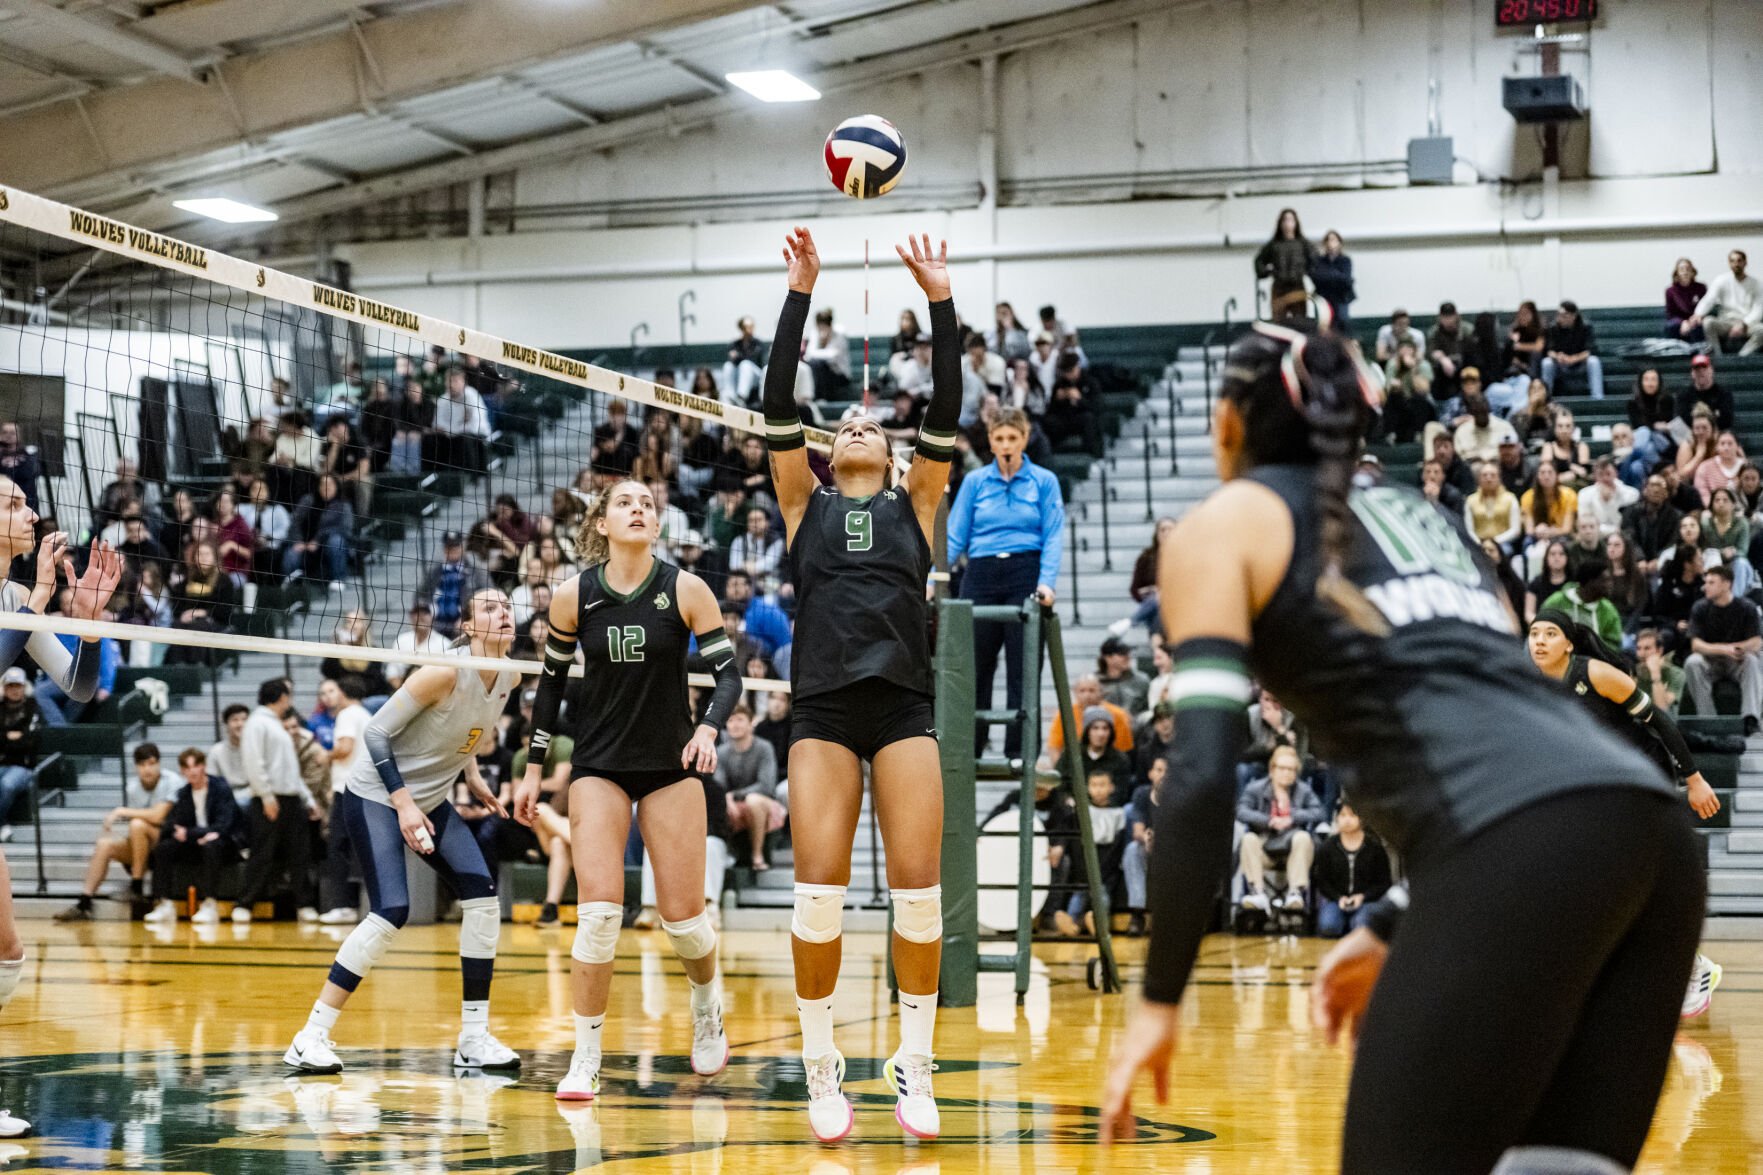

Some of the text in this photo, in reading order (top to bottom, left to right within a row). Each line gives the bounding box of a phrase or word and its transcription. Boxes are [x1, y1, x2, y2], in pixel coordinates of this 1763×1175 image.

[70, 210, 207, 269] WOLVES VOLLEYBALL
[313, 284, 419, 331] WOLVES VOLLEYBALL
[502, 341, 587, 379] WOLVES VOLLEYBALL
[845, 510, 873, 551] 9
[607, 625, 646, 662] 12
[456, 728, 484, 754] 3
